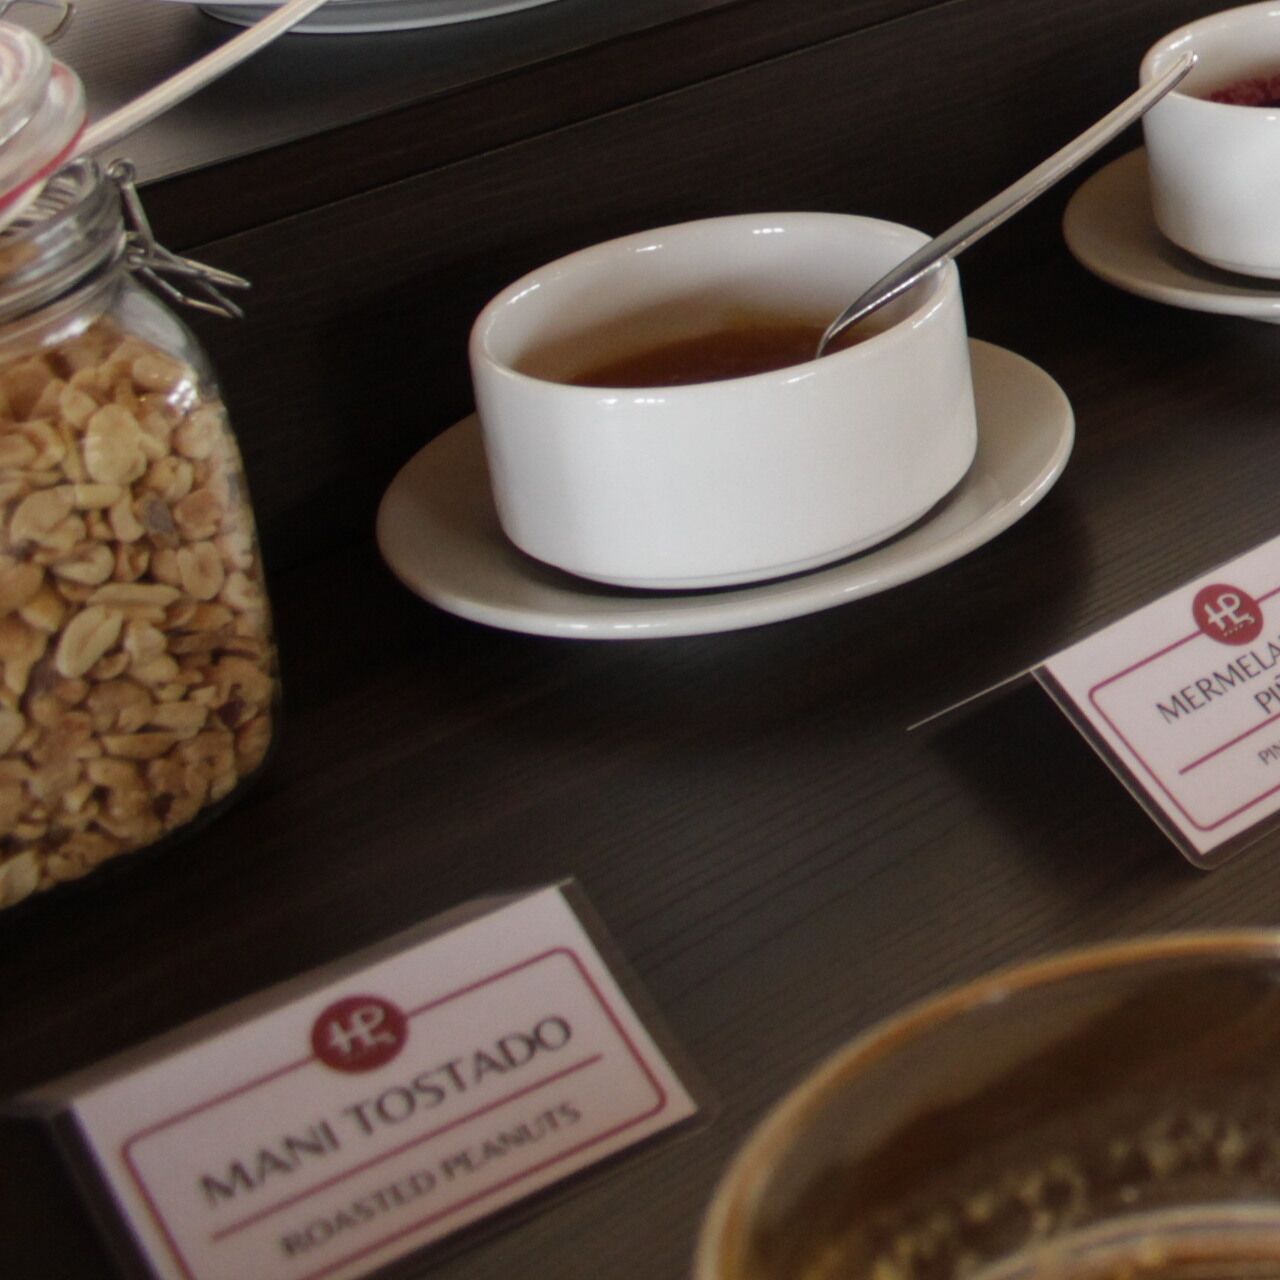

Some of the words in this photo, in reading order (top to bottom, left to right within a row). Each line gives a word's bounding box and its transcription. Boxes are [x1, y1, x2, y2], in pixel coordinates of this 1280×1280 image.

[199, 1125, 340, 1207] MANI
[346, 1014, 572, 1135] TOSTADO
[280, 1168, 433, 1256] ROASTED
[442, 1100, 582, 1179] PEANUTS
